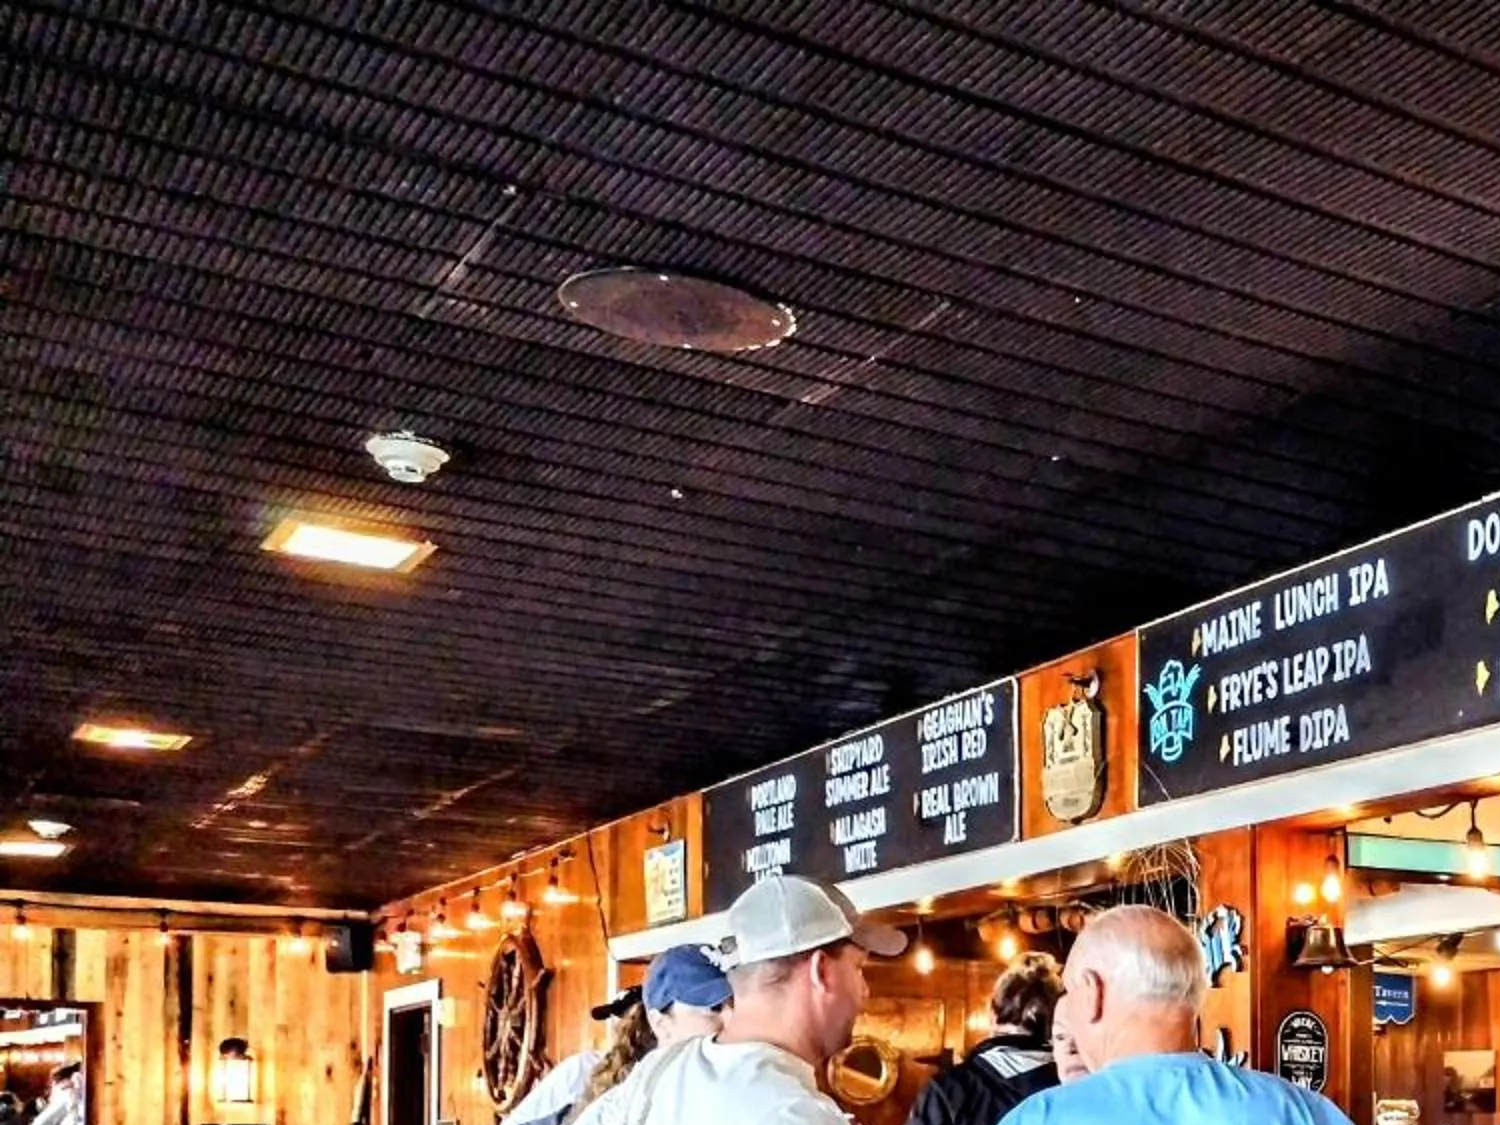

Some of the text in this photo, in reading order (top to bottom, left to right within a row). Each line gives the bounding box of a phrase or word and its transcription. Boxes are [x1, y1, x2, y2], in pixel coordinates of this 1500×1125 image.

[1202, 558, 1389, 657] MAINE LUNCH IPA
[1220, 633, 1372, 713] FRYE'S LEAP IPA
[923, 692, 995, 741] GEAGHAN'S
[1233, 703, 1350, 767] FLUME DIPA
[830, 734, 884, 776] SHIPYARD
[922, 727, 987, 774] IRISH RED
[825, 763, 891, 808] SUMMER ALE
[921, 772, 999, 819] REAL BROWN
[777, 801, 795, 833] ALE
[835, 806, 887, 846] ALLAGASH
[943, 811, 967, 845] ALE
